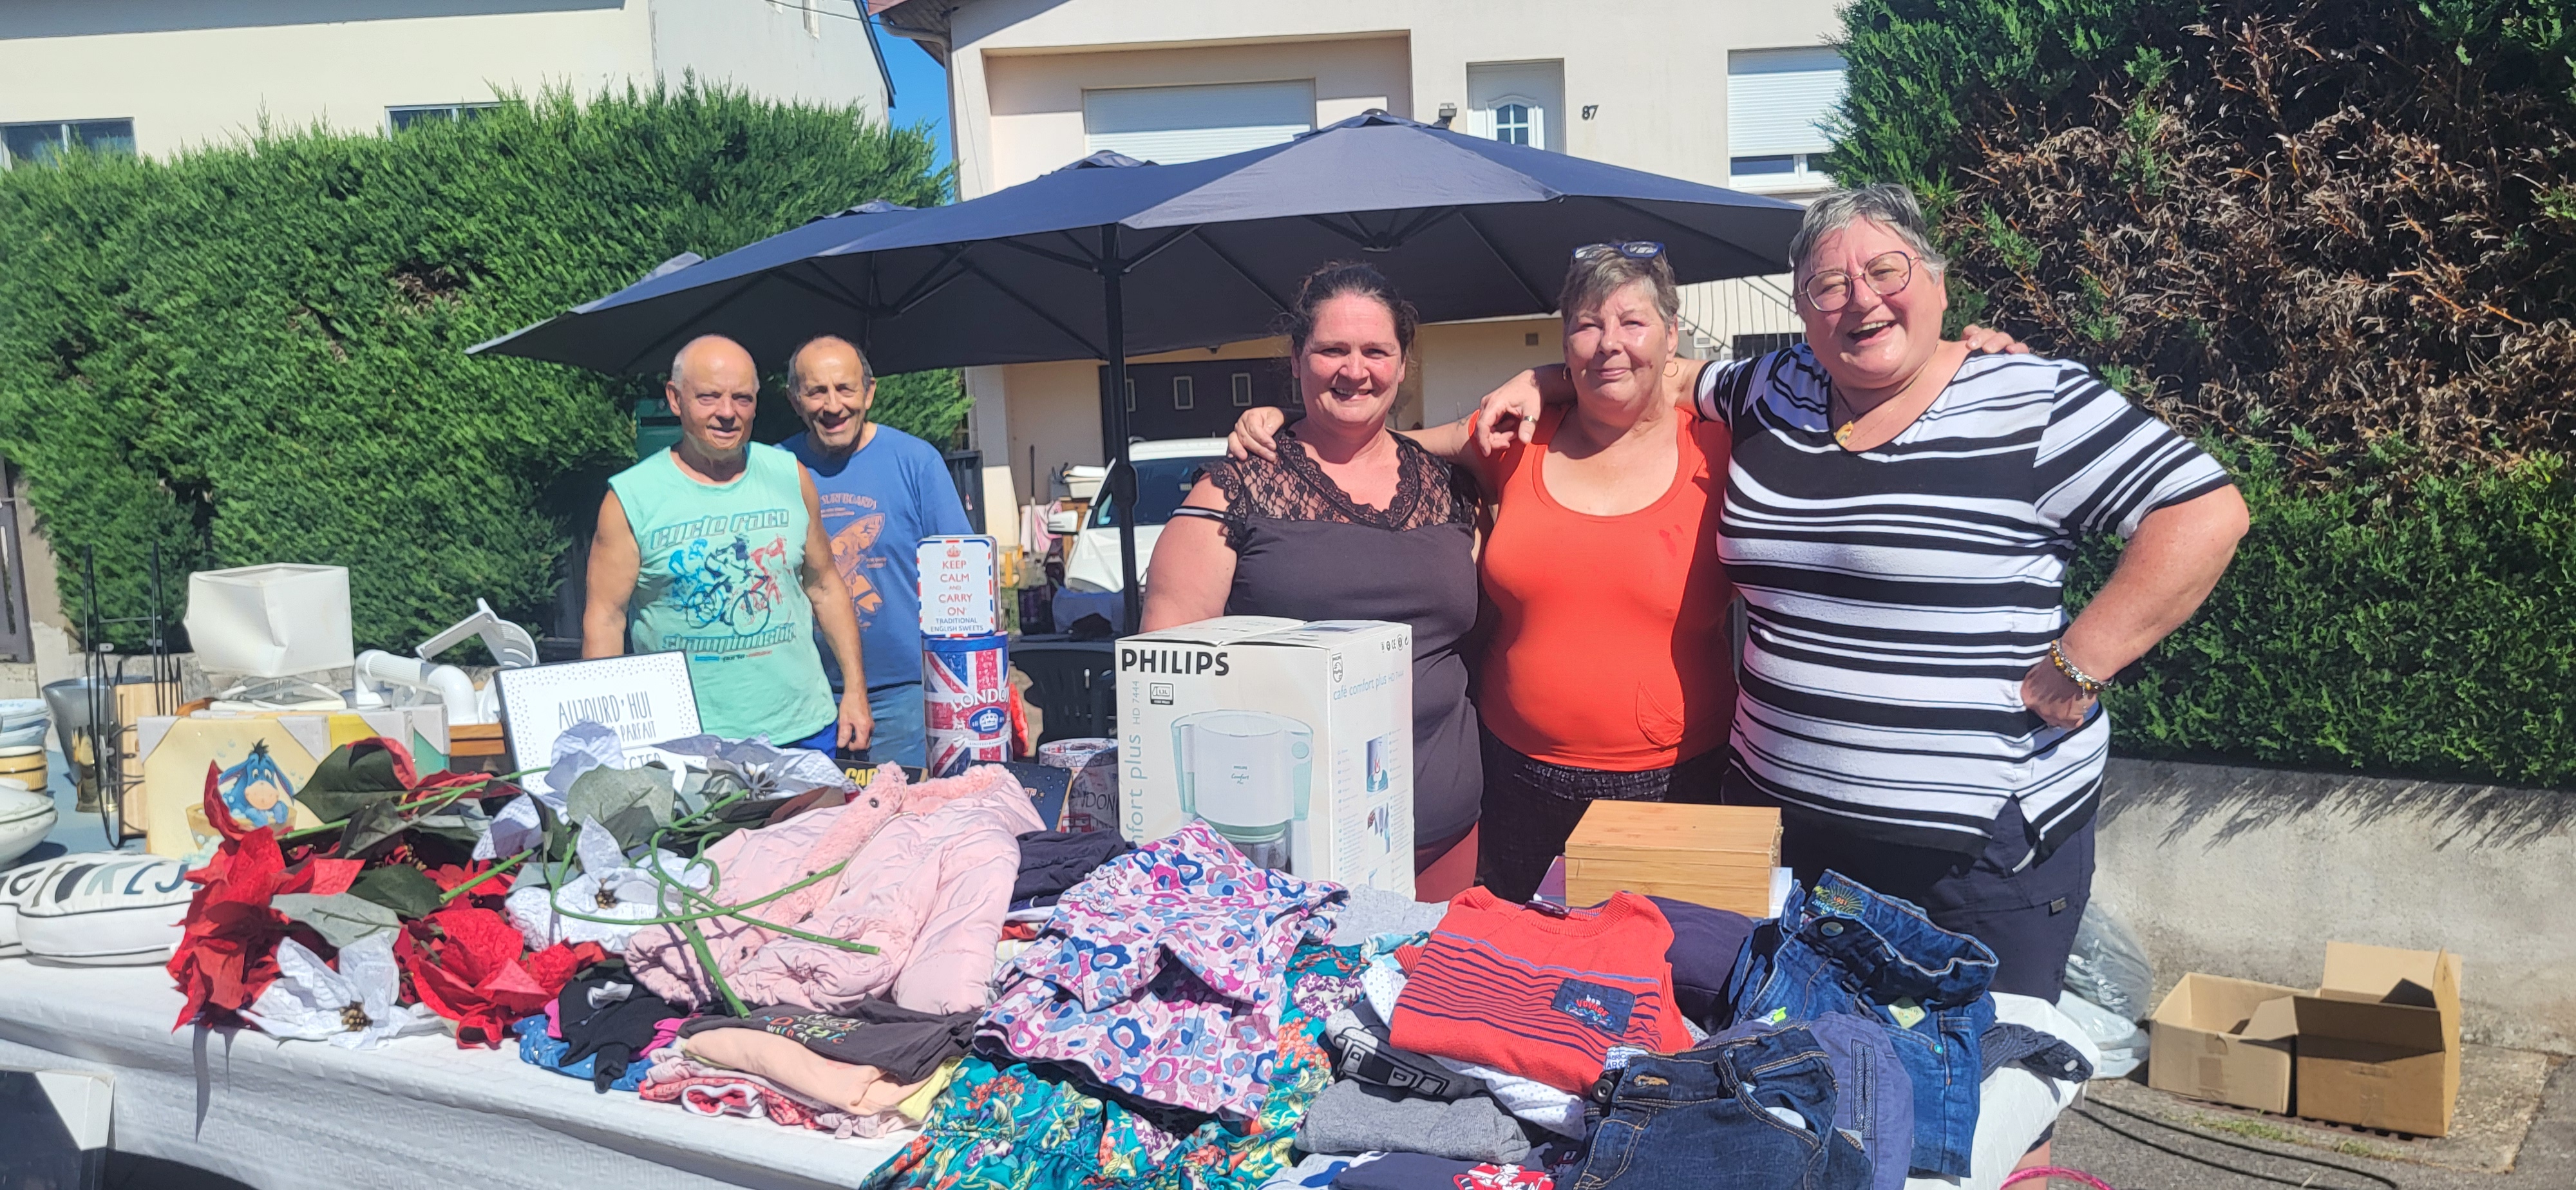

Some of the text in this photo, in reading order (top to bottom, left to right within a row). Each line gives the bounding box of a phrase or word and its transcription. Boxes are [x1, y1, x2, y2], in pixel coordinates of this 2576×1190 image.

[1582, 104, 1599, 120] 87
[942, 560, 967, 569] KEEP
[940, 573, 970, 583] CALM
[938, 594, 973, 603] CARRY
[947, 607, 965, 616] ON
[1121, 648, 1230, 676] PHILIPS
[1333, 685, 1347, 701] café
[1349, 678, 1374, 695] comfort
[1376, 674, 1387, 690] plus
[1132, 708, 1141, 725] HD
[620, 720, 657, 742] PARFAIT
[1124, 734, 1148, 779] plus
[1575, 999, 1609, 1017] VOYAGE
